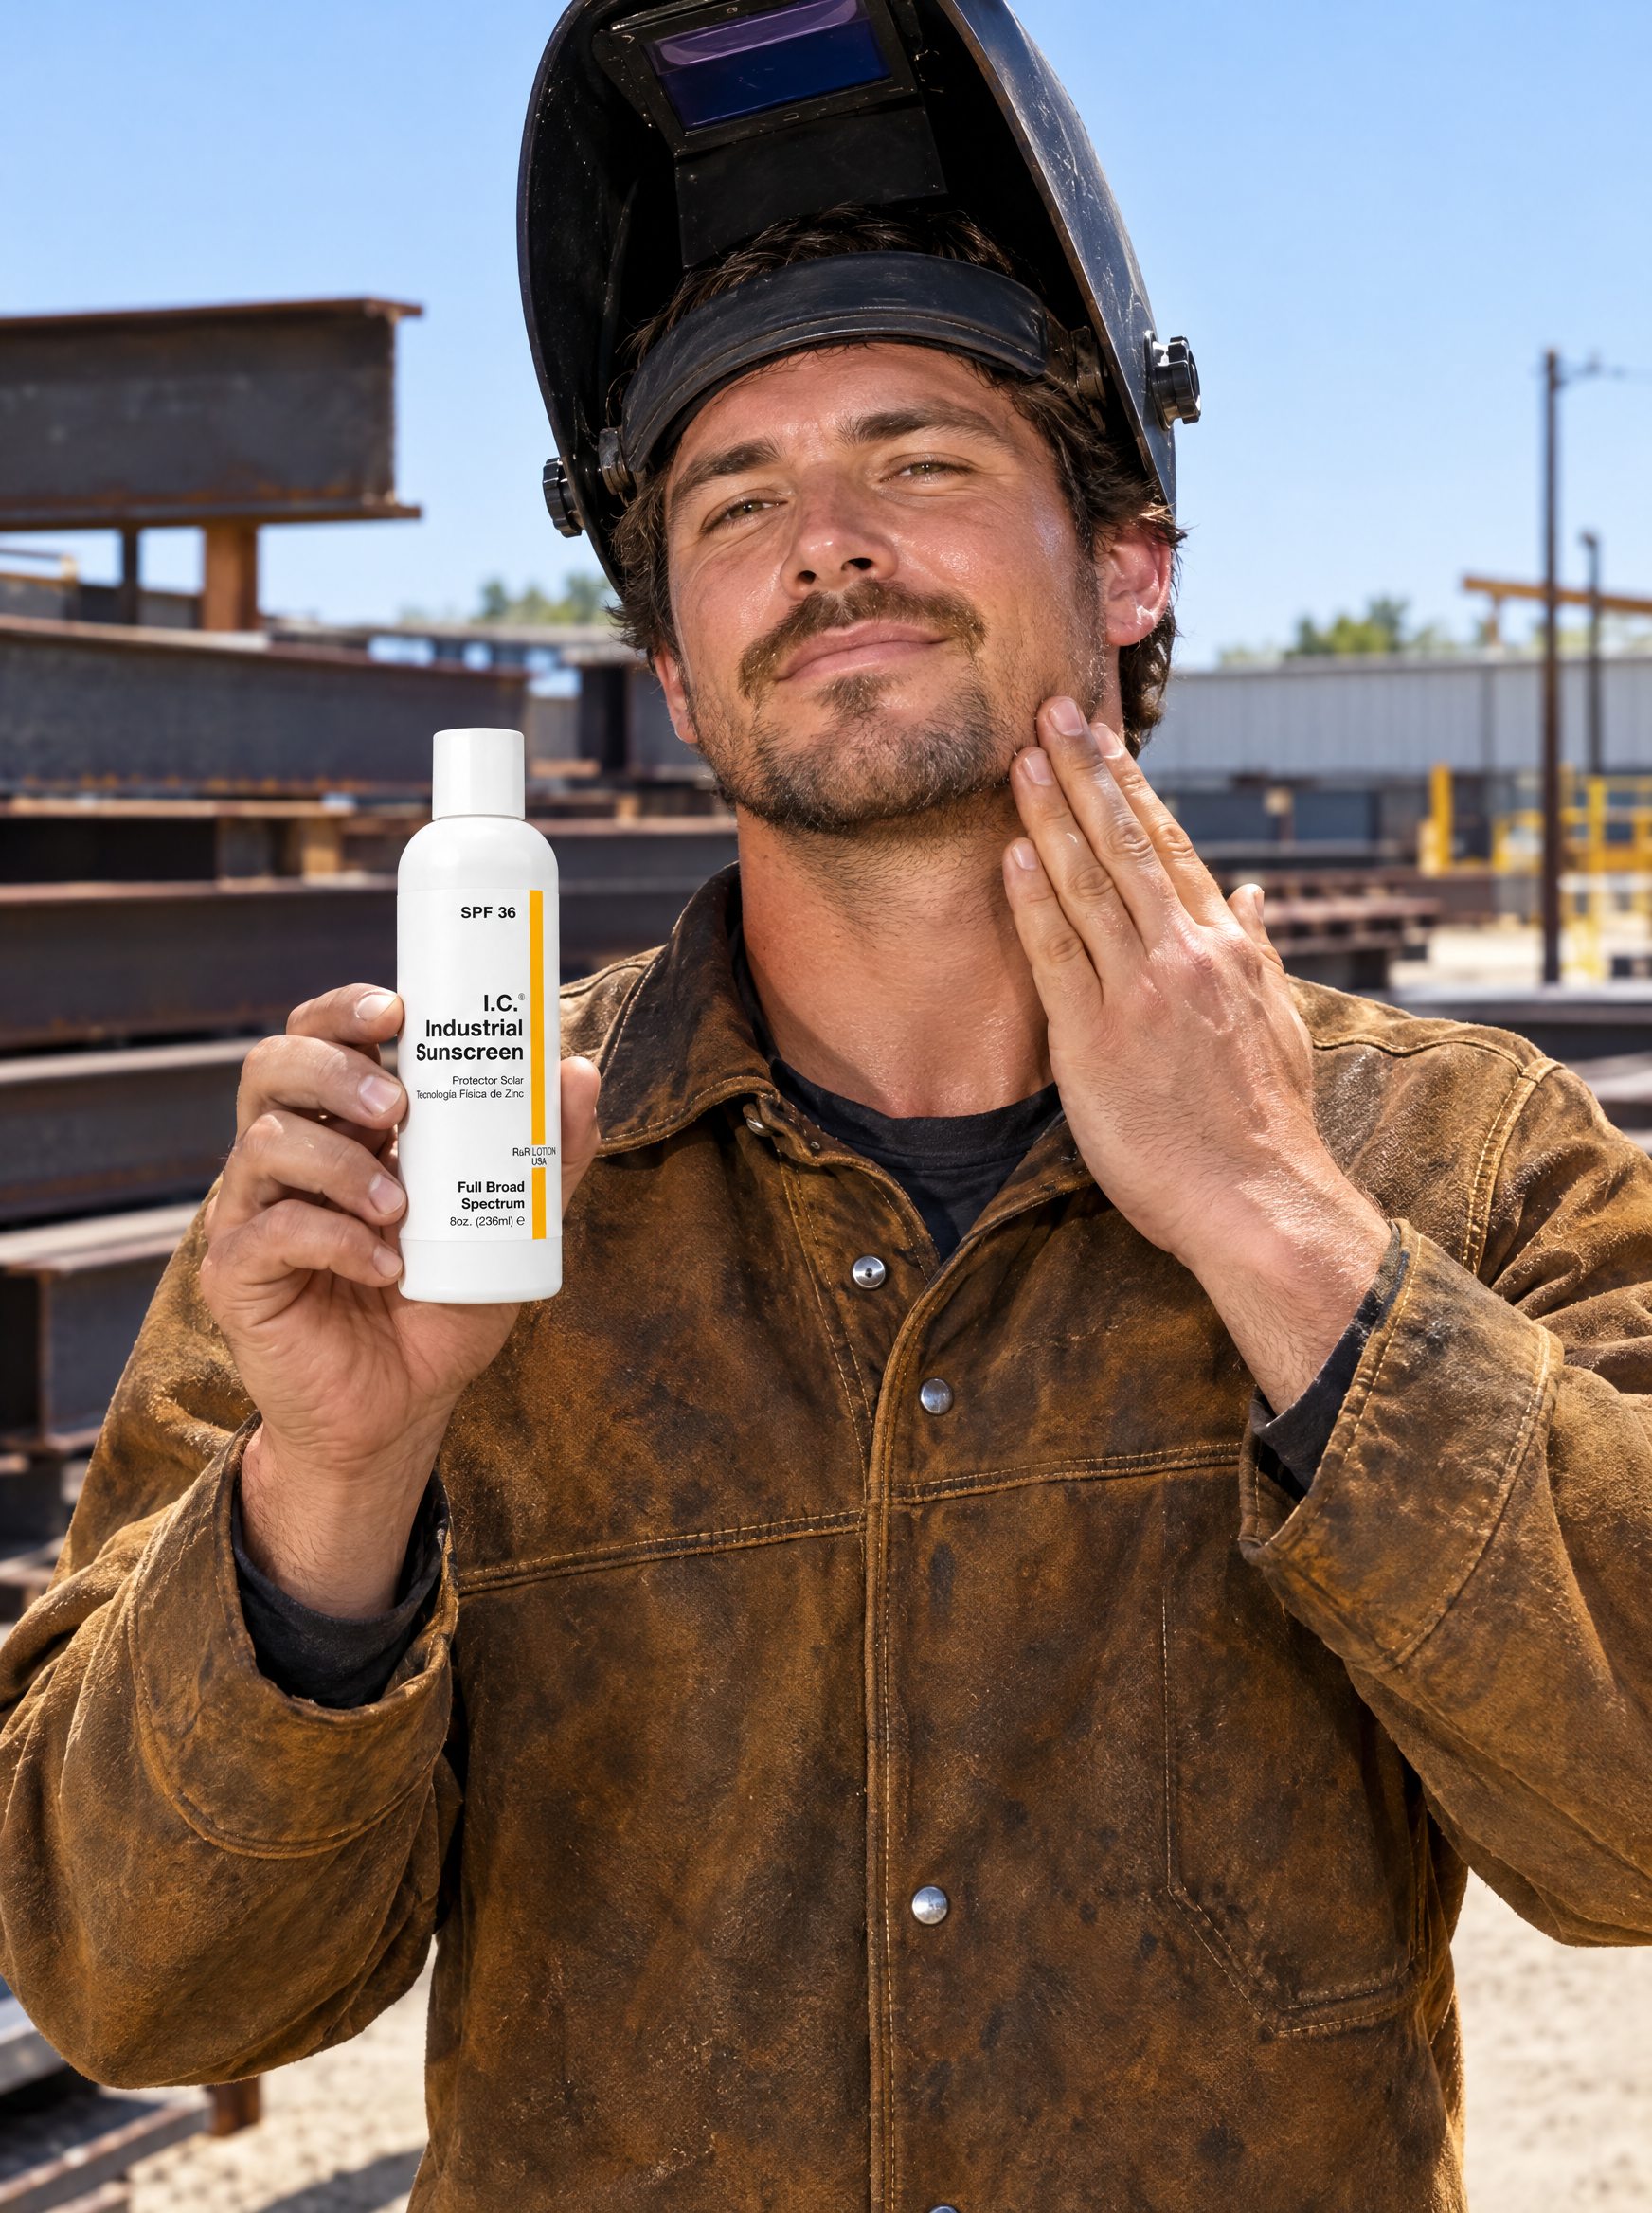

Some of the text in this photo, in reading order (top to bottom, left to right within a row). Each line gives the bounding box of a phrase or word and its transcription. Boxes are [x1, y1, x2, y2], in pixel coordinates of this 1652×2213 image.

[460, 907, 516, 919] SPF 36
[426, 1019, 523, 1037] Industrial
[416, 1043, 524, 1061] Sunscreen
[452, 1076, 524, 1086] Protector Solar
[417, 1089, 524, 1101] Tecnología Física de Zinc
[531, 1147, 556, 1156] LOTION
[531, 1157, 547, 1166] USA
[458, 1181, 525, 1193] Full Broad
[461, 1197, 525, 1212] Spectrum
[450, 1216, 472, 1226] 8oz.
[476, 1216, 513, 1228] (236ml)
